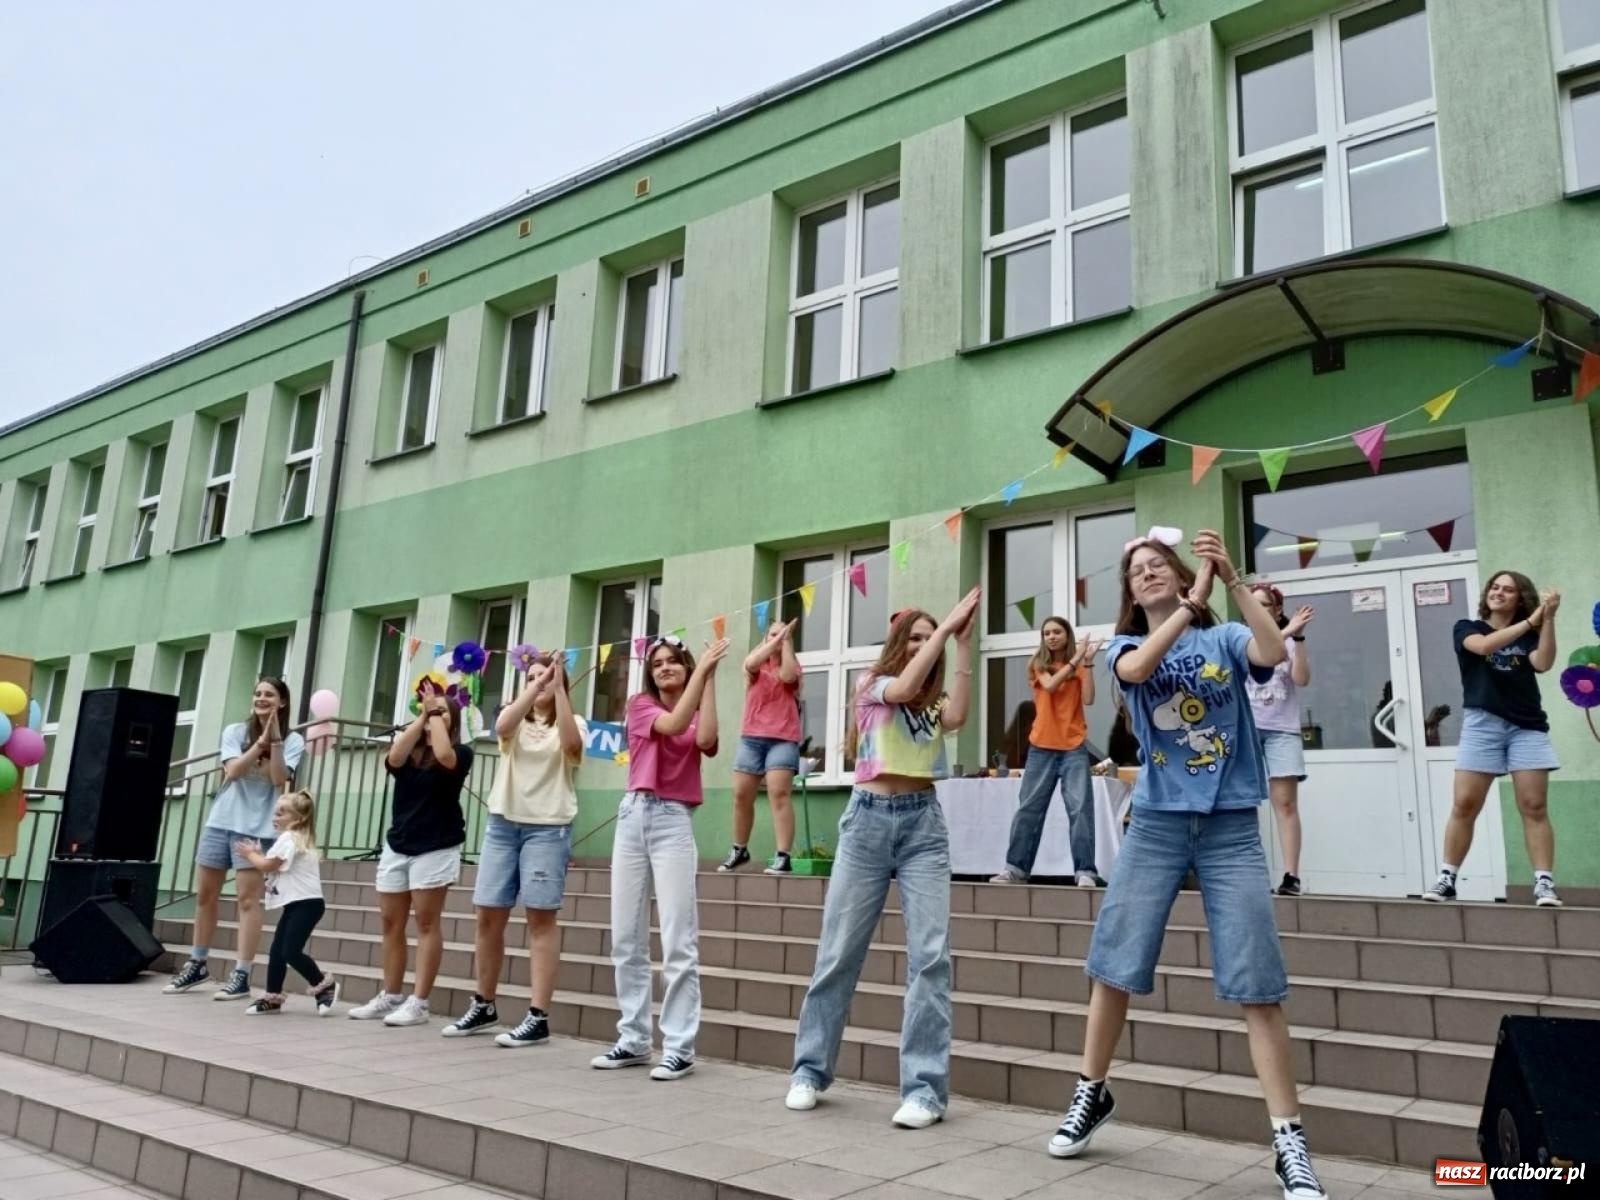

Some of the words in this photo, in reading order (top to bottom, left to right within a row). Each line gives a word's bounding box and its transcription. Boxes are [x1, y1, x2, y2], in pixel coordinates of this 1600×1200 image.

[1146, 672, 1198, 702] AWAY
[1200, 682, 1212, 694] BY
[1205, 687, 1233, 711] FUN
